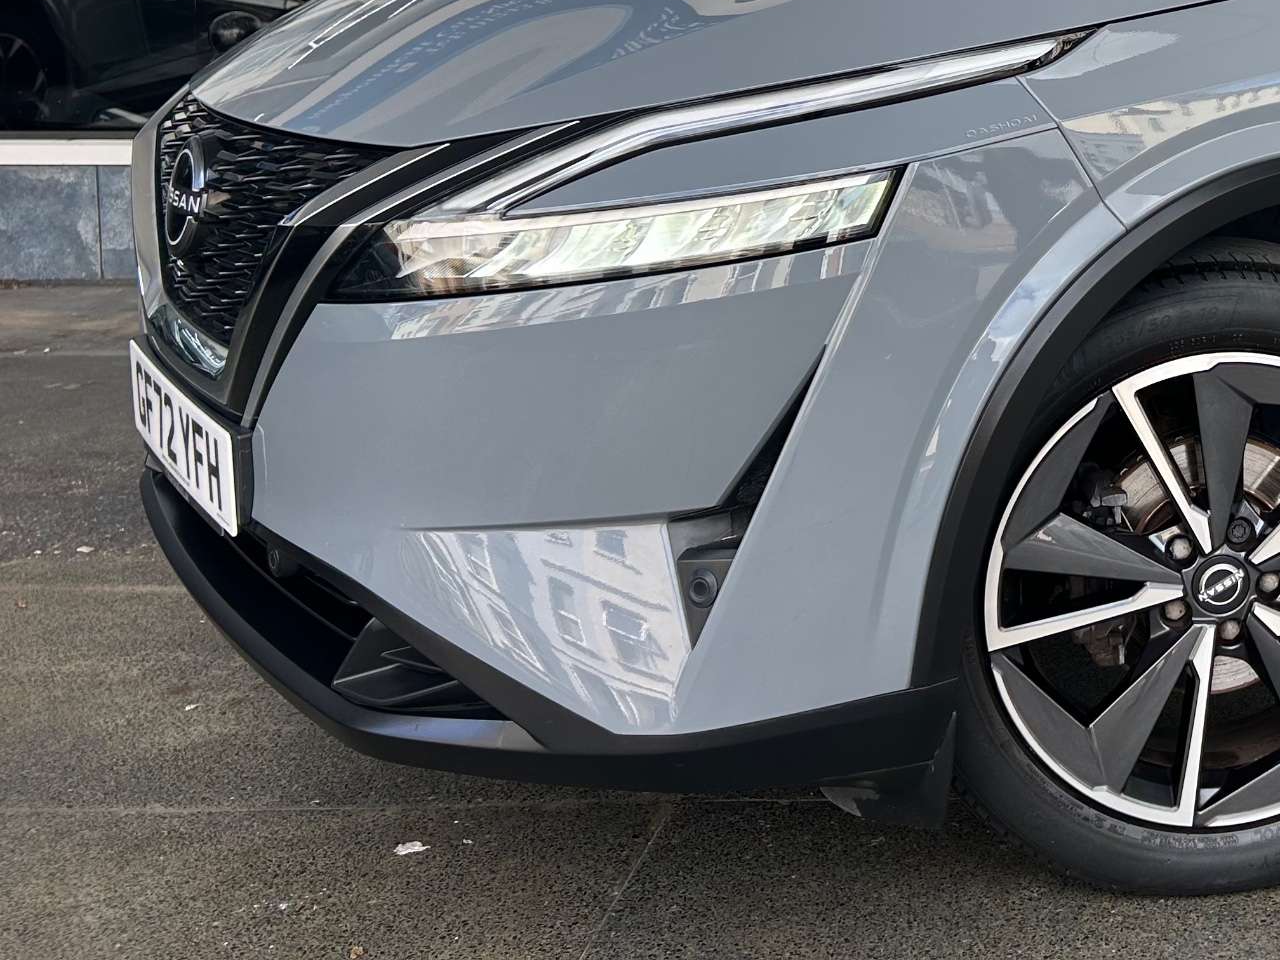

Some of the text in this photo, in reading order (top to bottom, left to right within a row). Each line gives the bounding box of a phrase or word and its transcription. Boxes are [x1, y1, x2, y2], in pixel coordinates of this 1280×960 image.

[169, 187, 201, 214] SSAN
[136, 360, 178, 467] GF72
[179, 405, 223, 512] YFH
[1198, 568, 1245, 602] NISSAN
